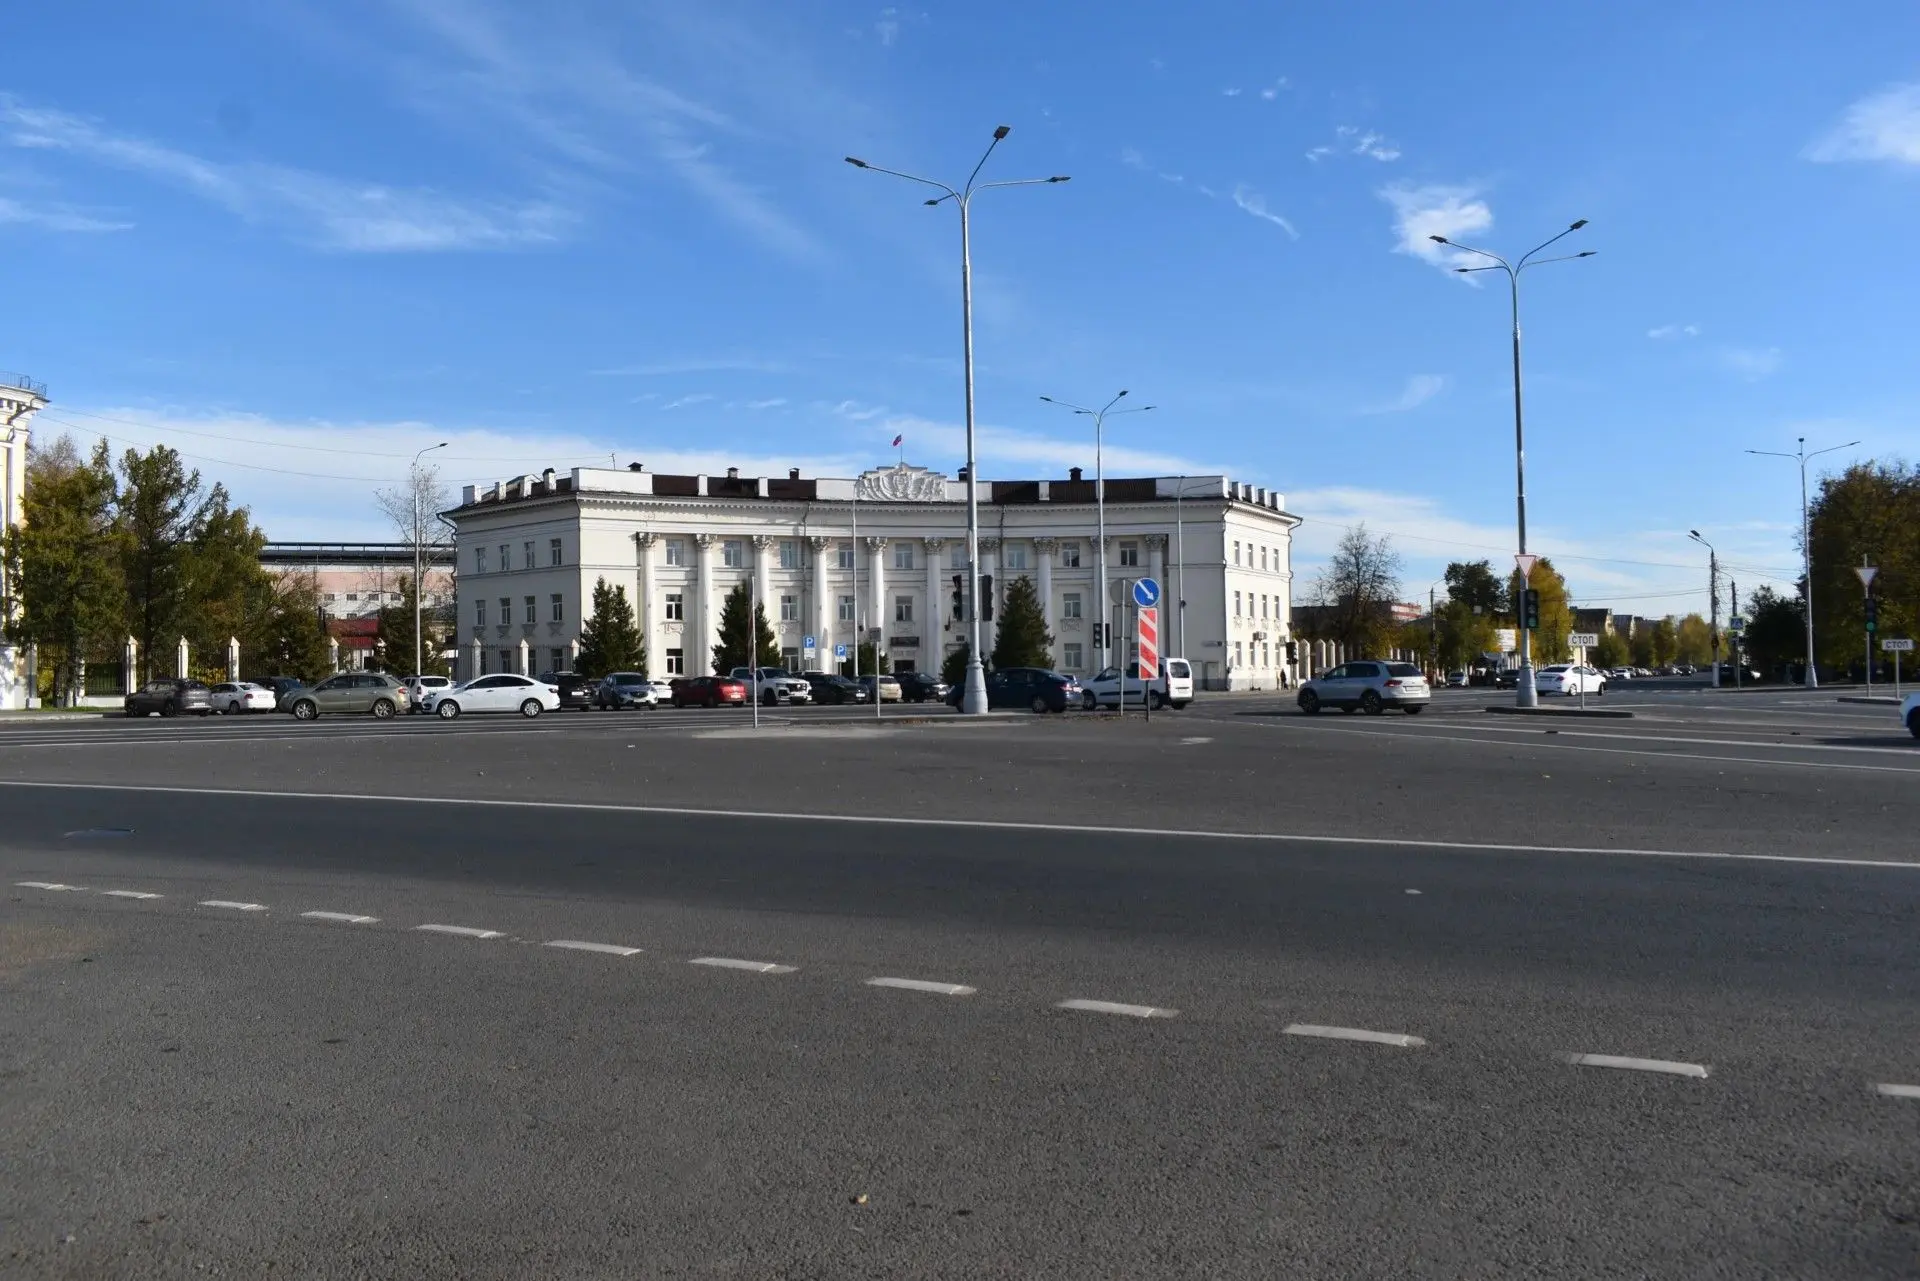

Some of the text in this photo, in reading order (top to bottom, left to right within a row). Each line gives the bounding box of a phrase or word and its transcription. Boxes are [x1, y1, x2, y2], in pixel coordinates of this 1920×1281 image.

[806, 637, 813, 647] P
[1571, 635, 1594, 645] СТОП
[1885, 640, 1908, 648] СТОП
[837, 645, 844, 655] P
